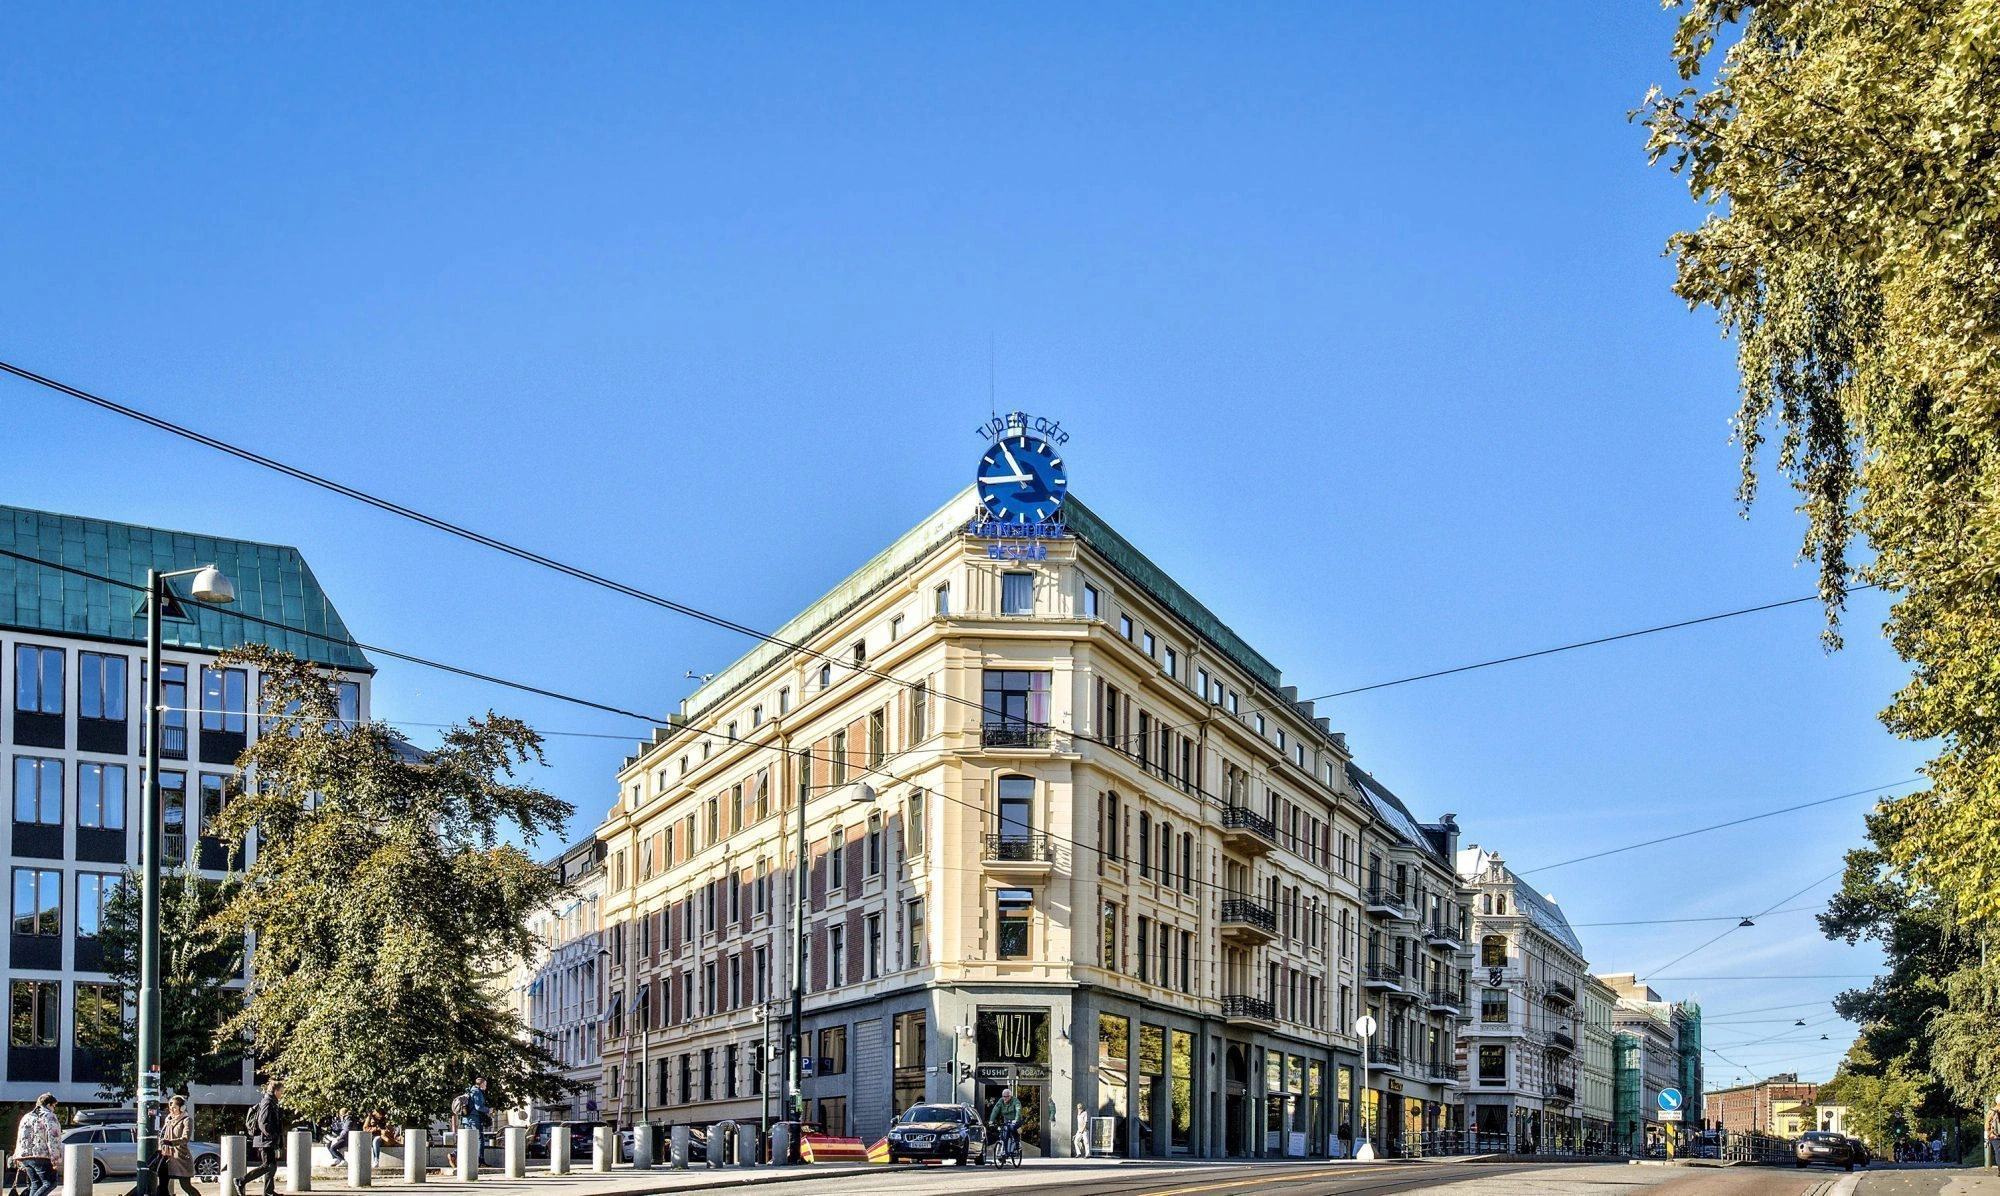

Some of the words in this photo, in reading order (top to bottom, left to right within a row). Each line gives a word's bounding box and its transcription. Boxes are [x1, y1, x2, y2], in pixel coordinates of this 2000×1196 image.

[976, 411, 1028, 441] TIDEN
[1035, 417, 1070, 446] GÅR
[987, 541, 1047, 561] BESTÅR
[996, 1014, 1031, 1057] YUZU
[802, 1058, 809, 1068] P
[981, 1068, 1005, 1076] SUSHI
